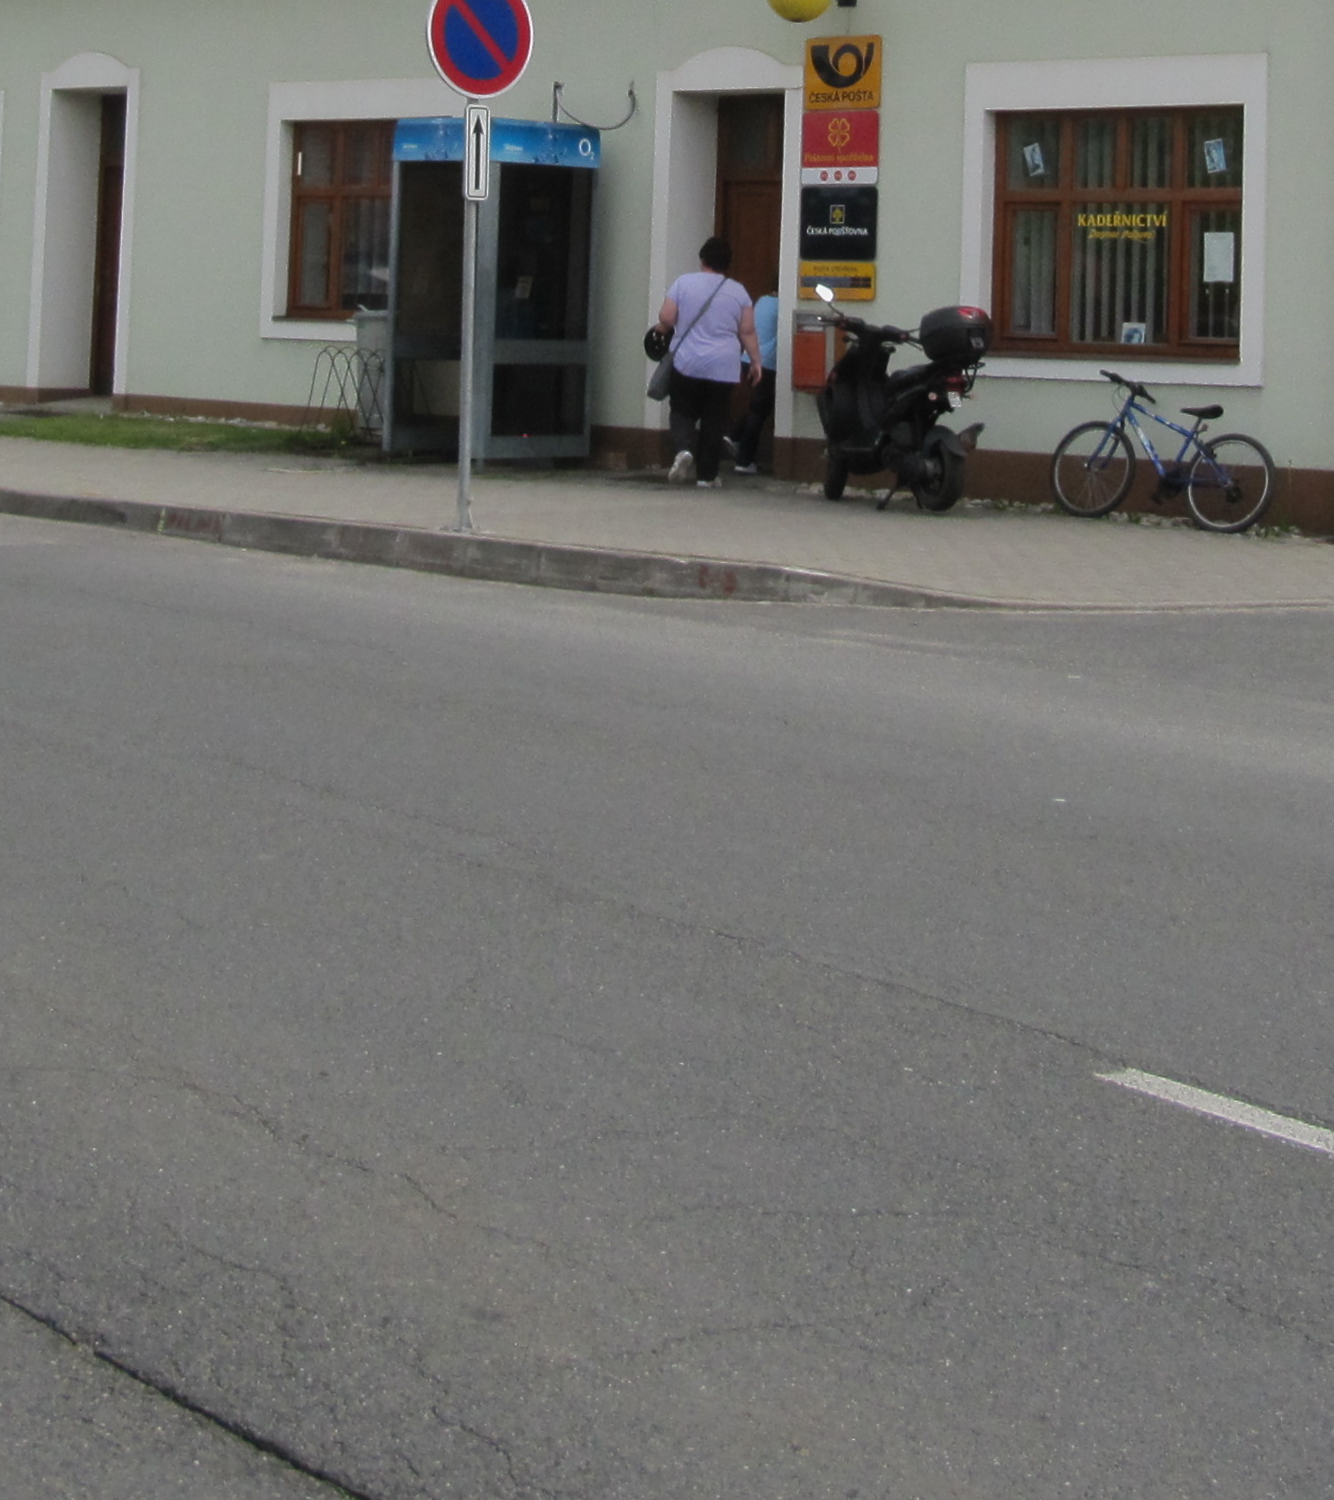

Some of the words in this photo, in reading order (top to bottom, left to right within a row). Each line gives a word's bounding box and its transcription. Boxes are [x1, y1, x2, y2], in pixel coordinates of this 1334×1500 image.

[809, 90, 840, 103] ČESKÁ
[842, 88, 874, 102] POŠTA
[1077, 210, 1168, 228] KADEŘNICTVÍ
[806, 225, 828, 235] ČESKÁ
